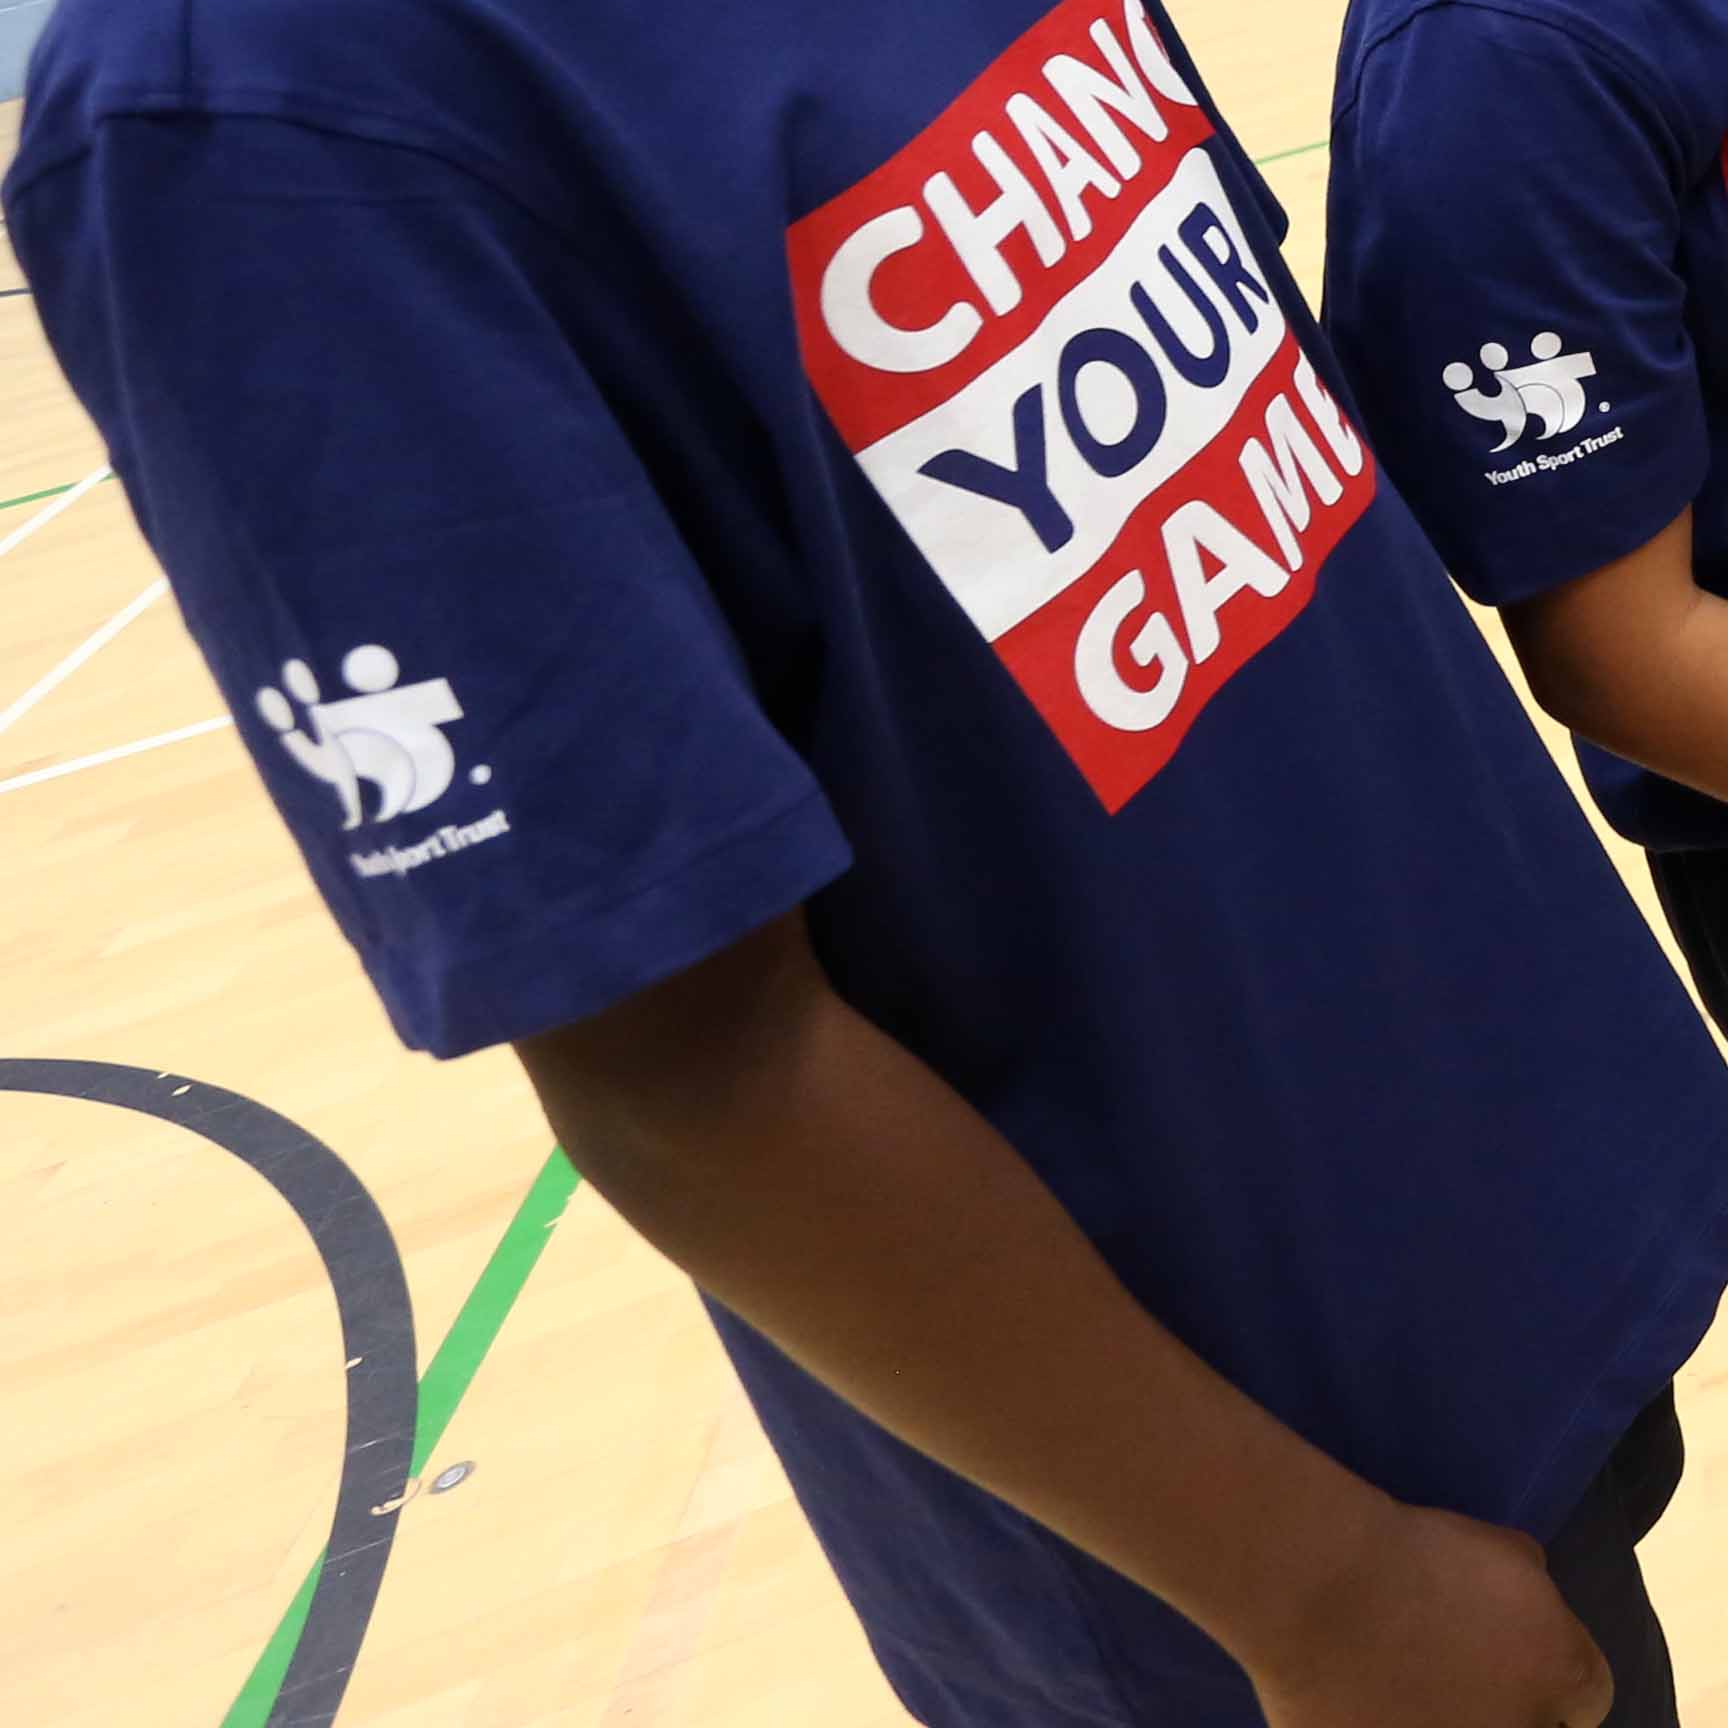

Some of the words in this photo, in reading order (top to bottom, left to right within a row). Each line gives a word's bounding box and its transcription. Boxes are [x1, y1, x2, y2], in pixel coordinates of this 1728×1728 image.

[918, 199, 1270, 554] YOUR
[1073, 348, 1365, 732] GAME
[1485, 460, 1537, 486] Youth
[1535, 445, 1585, 470] Sport
[1579, 425, 1625, 454] Trust
